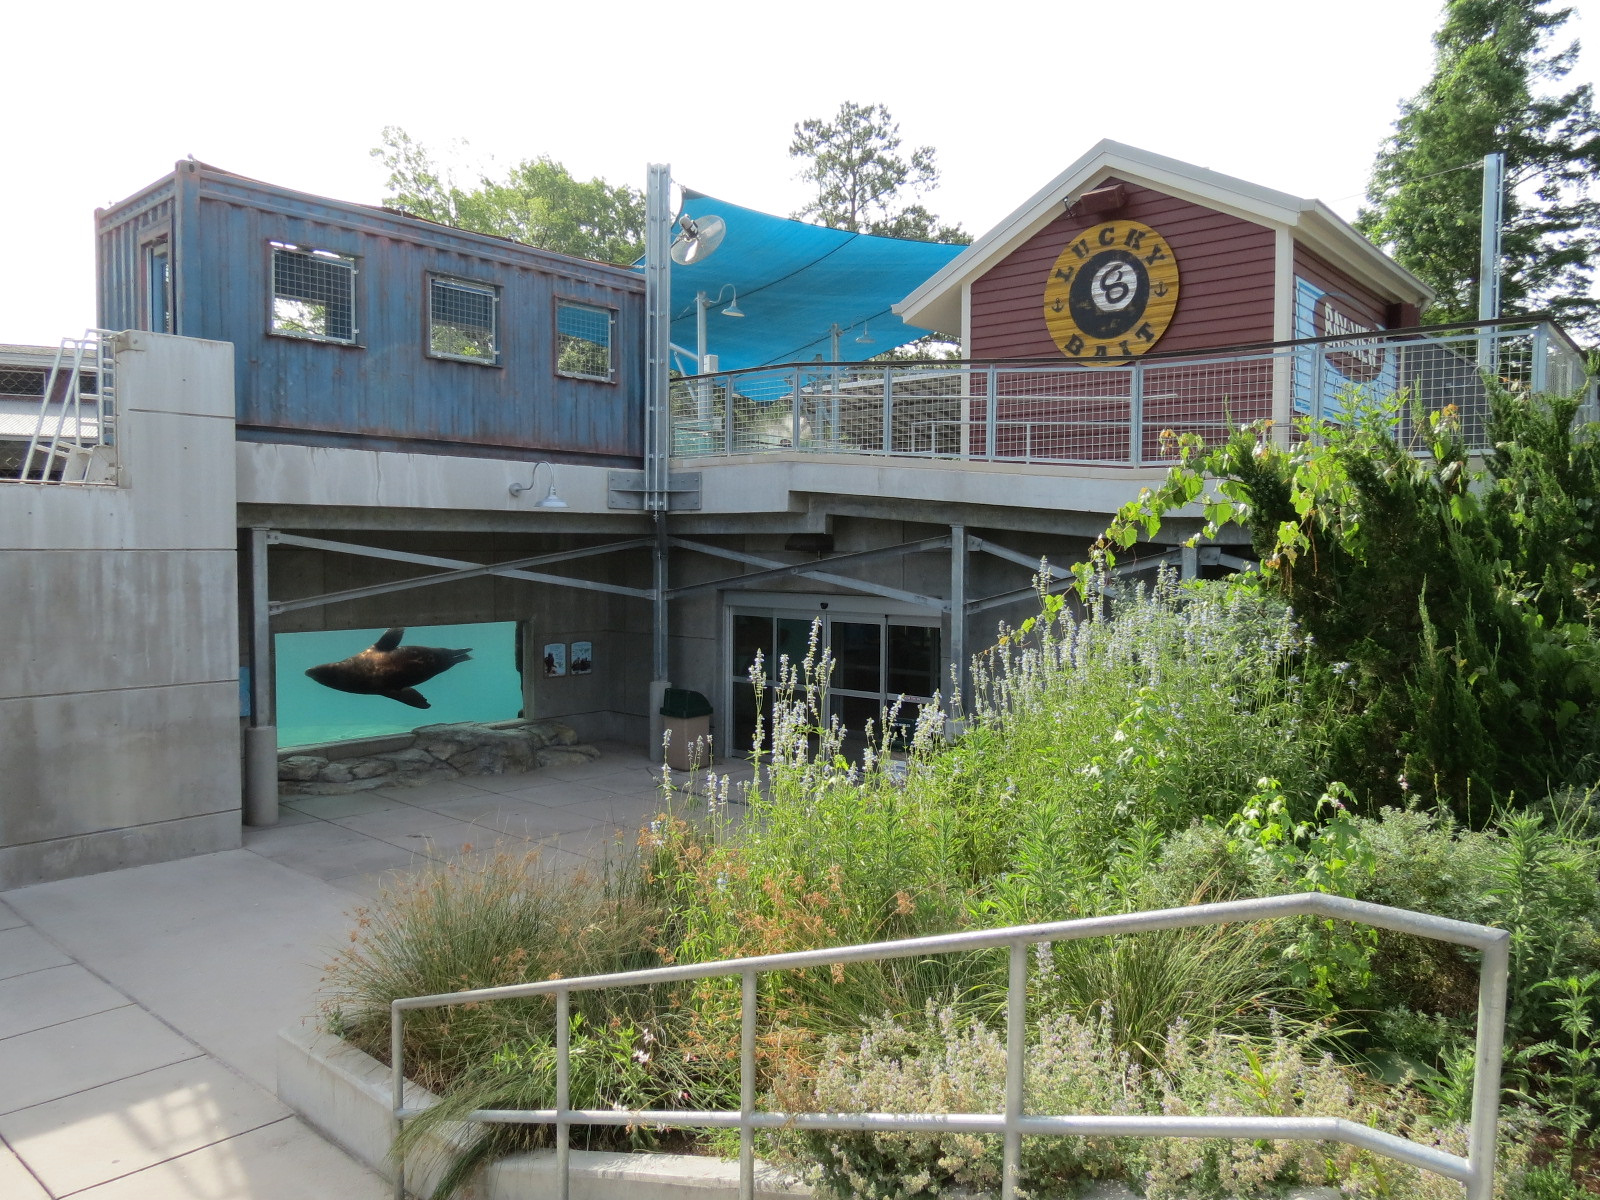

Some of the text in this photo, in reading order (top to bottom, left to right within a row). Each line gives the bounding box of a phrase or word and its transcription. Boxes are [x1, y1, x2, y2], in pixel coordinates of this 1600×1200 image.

[1055, 227, 1166, 282] LUCKY
[1100, 264, 1129, 304] 8
[1064, 322, 1155, 363] BAIT
